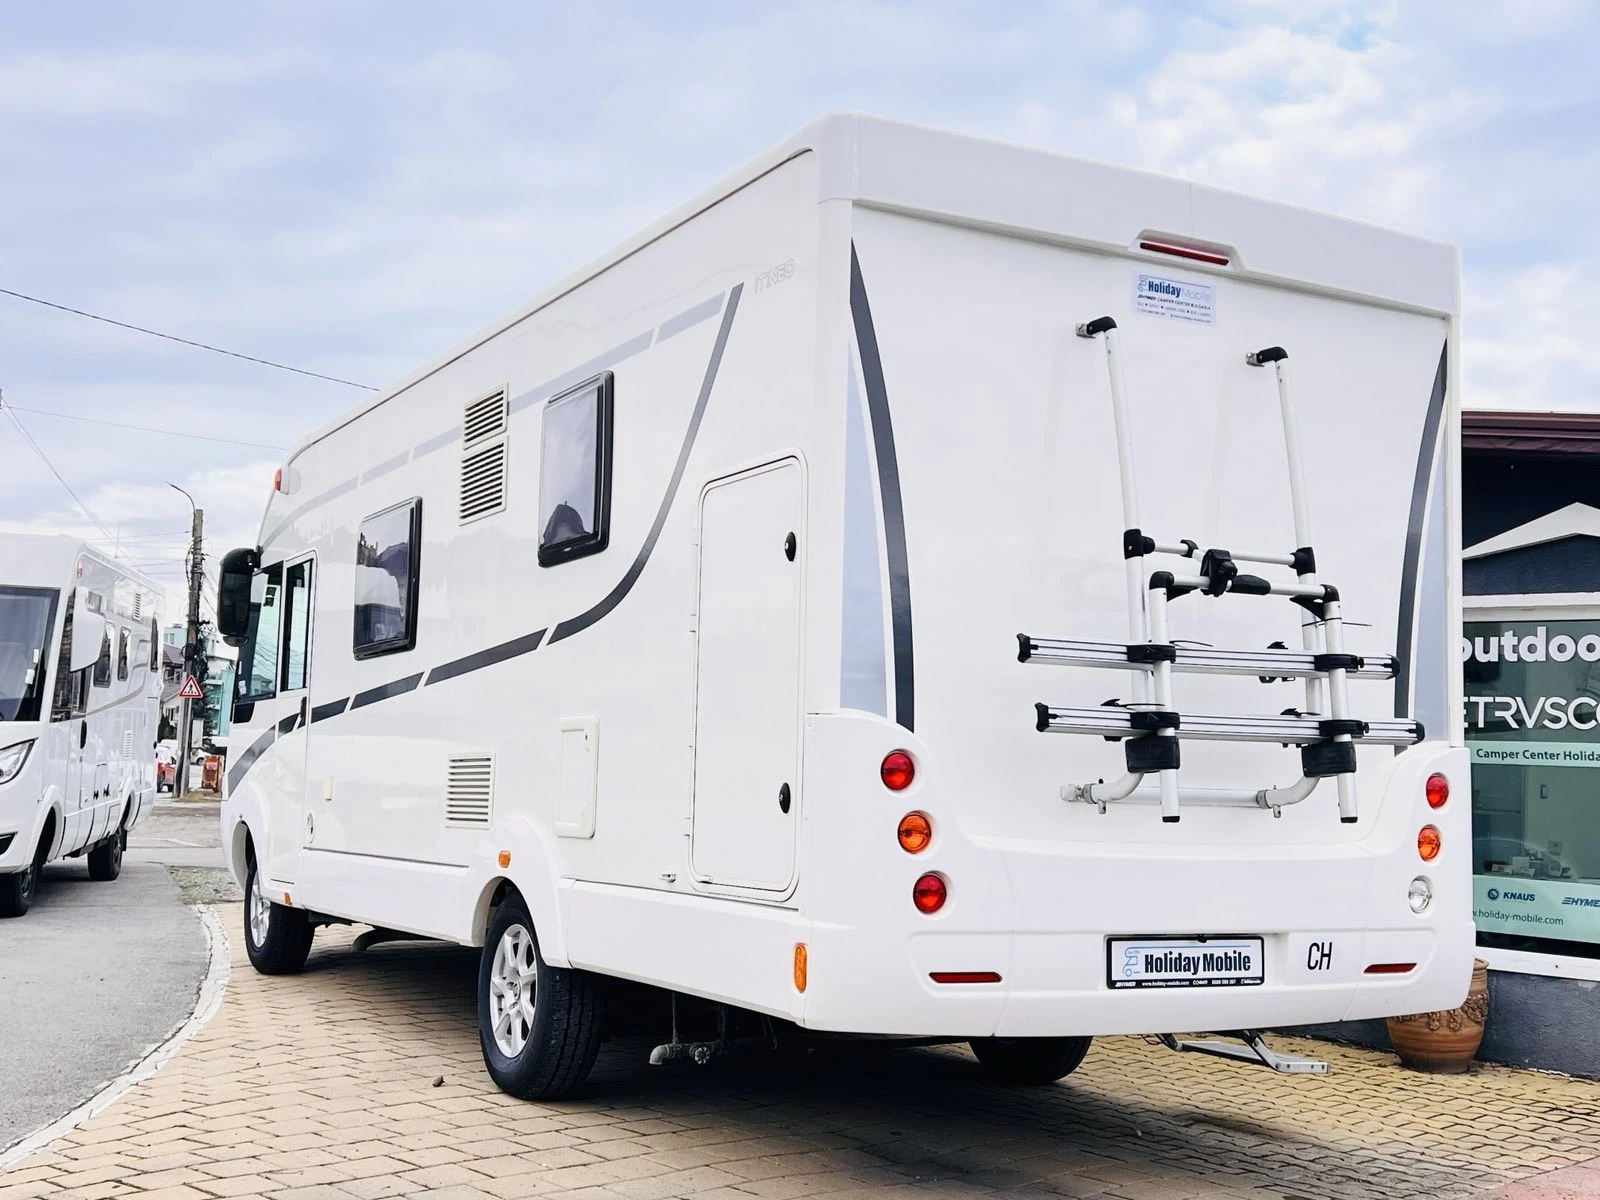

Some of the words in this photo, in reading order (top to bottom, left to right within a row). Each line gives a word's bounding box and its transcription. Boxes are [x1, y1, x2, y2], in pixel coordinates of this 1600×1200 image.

[1148, 280, 1181, 298] Holiday
[1182, 288, 1211, 301] Mobile
[1464, 696, 1600, 730] TRVSC
[1476, 748, 1520, 761] Camper
[1522, 749, 1560, 760] Center
[1563, 751, 1600, 762] Holida
[1503, 891, 1536, 902] KNAUS
[1144, 951, 1200, 976] Holiday
[1203, 950, 1251, 972] Mobile
[1307, 942, 1333, 970] CH
